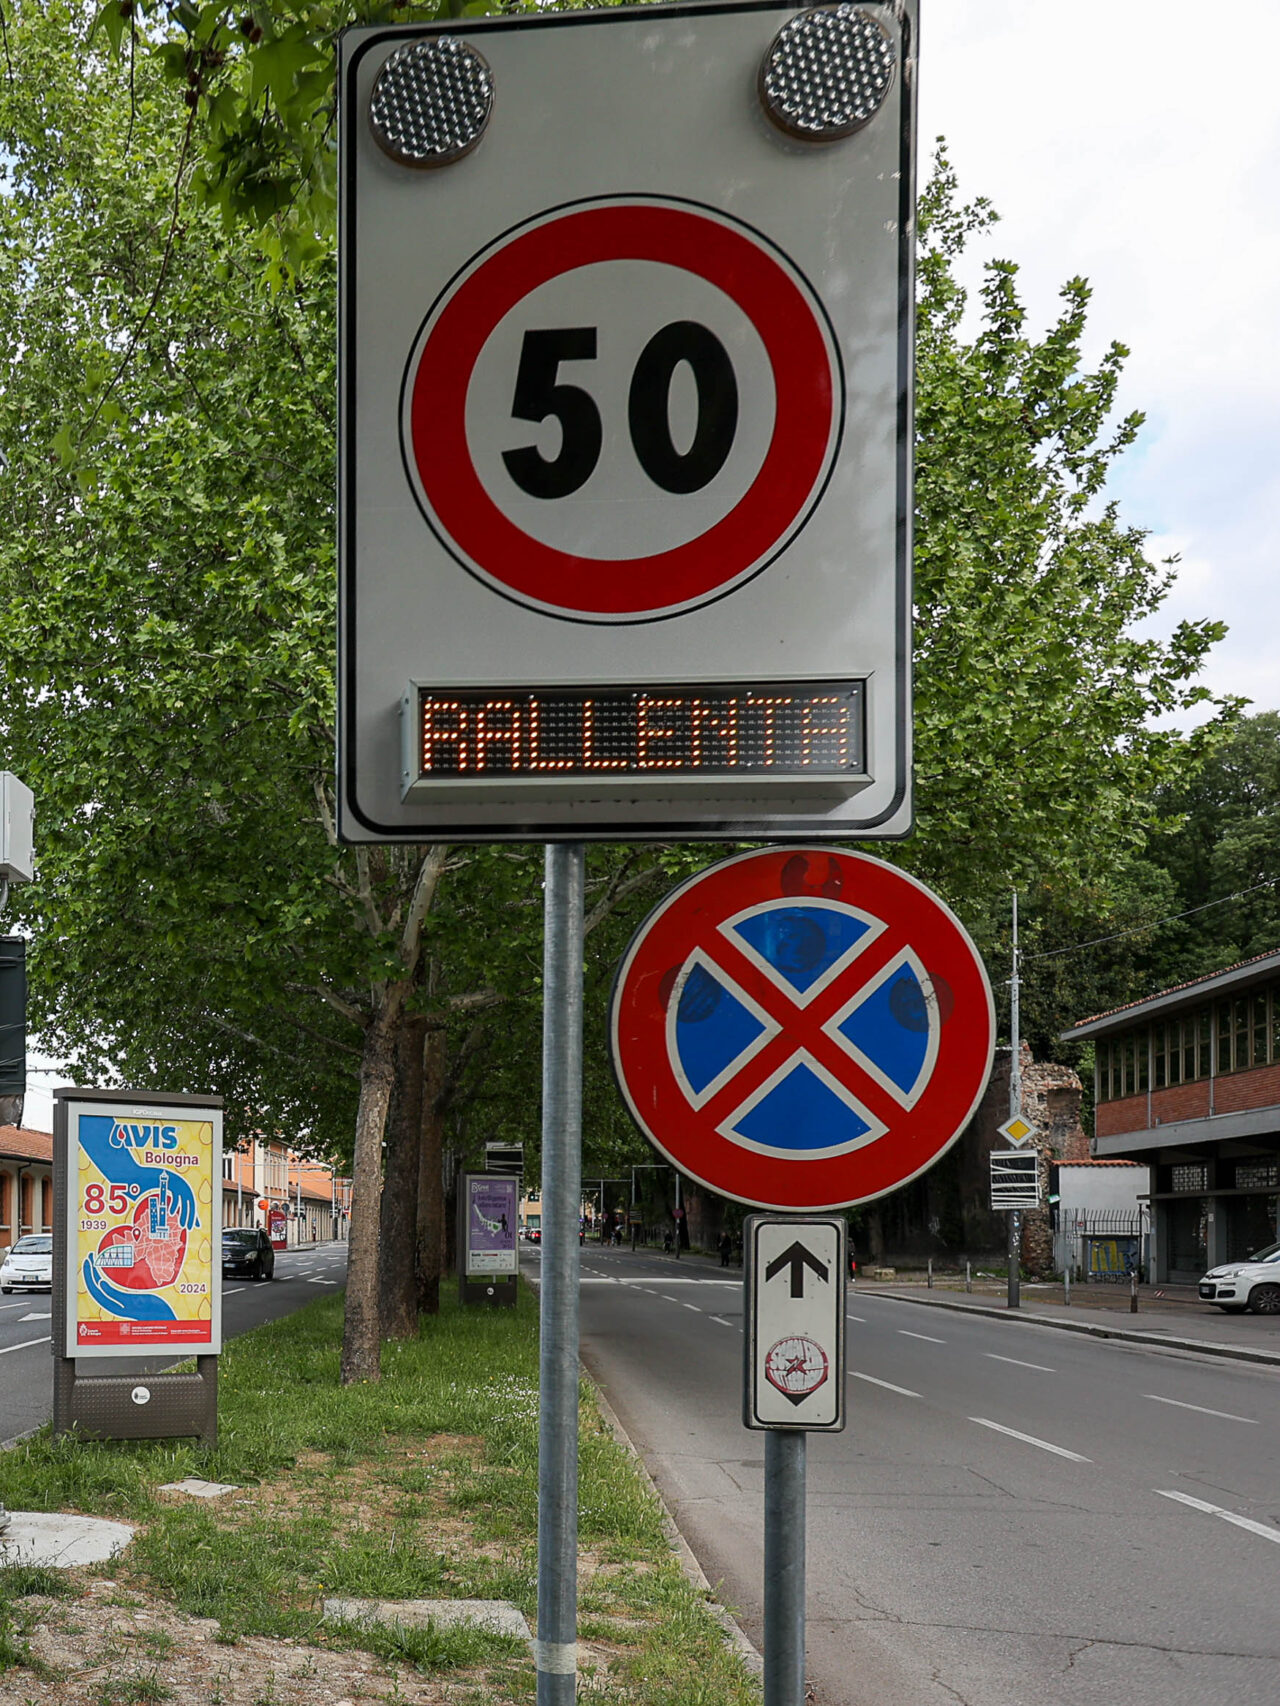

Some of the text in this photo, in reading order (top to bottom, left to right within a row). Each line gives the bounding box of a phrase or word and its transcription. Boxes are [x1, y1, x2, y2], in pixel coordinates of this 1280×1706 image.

[501, 320, 738, 499] 50
[423, 696, 851, 770] RALLENTA
[109, 1124, 178, 1149] AVIS
[145, 1151, 199, 1168] Bologna
[80, 1220, 107, 1230] 1939
[180, 1283, 206, 1294] 2024
